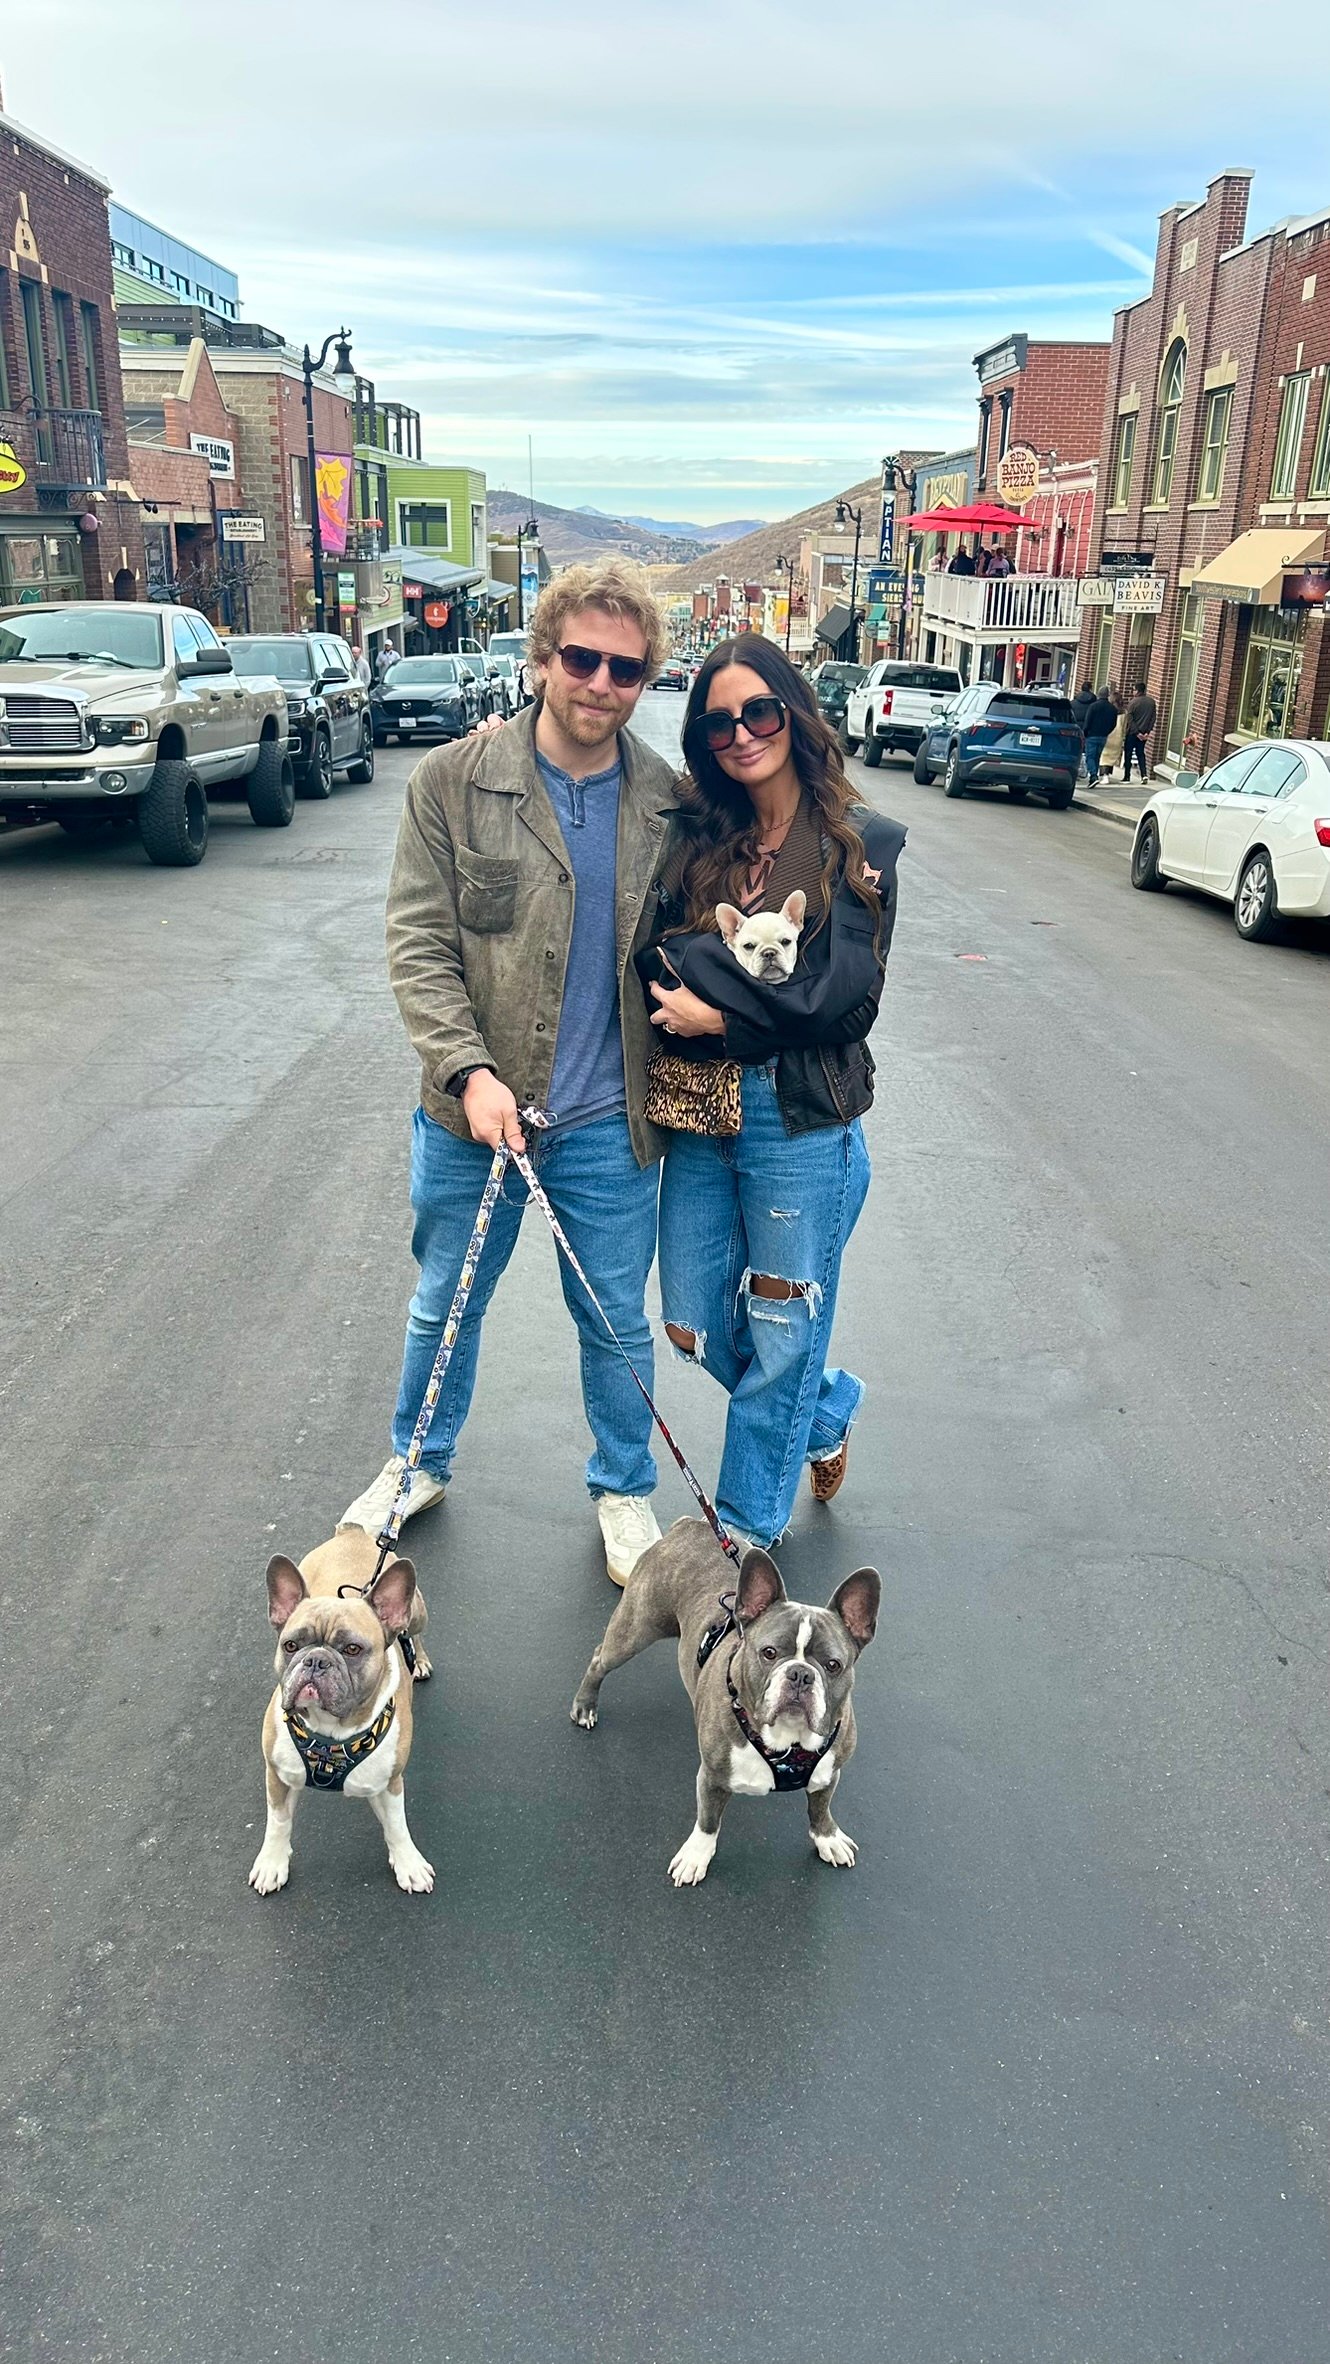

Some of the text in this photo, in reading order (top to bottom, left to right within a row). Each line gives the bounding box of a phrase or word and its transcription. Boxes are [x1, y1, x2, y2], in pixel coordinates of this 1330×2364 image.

[196, 443, 230, 462] THE EATING
[1010, 451, 1027, 462] RED
[1002, 462, 1035, 475] BANJO
[1001, 475, 1035, 488] PIZZA
[239, 521, 262, 529] EATING
[881, 506, 892, 561] PTIAN
[875, 581, 886, 591] AN
[1118, 581, 1150, 589] DAVID
[1117, 590, 1162, 601] BEAVIS
